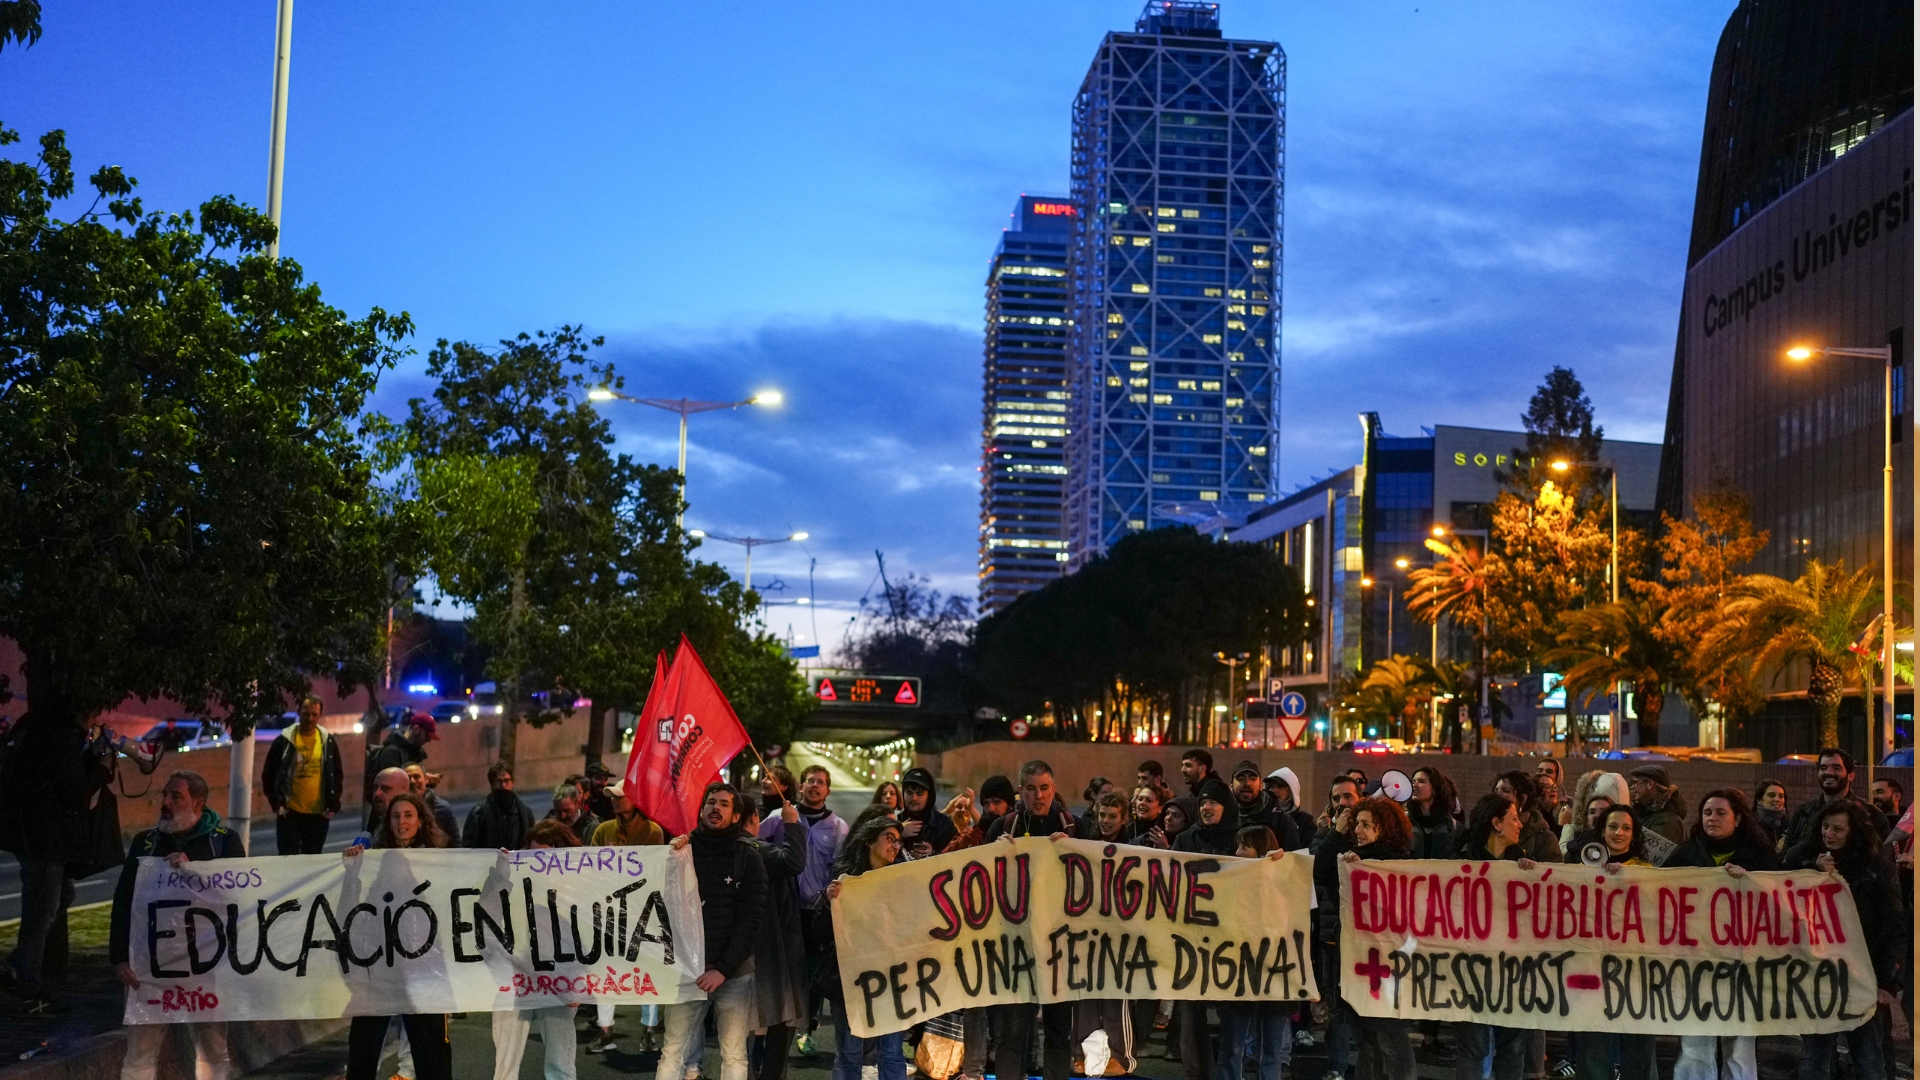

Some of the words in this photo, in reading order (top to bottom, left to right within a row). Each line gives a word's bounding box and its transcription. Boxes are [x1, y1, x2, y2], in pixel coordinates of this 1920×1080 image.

[1704, 259, 1785, 337] Campus
[1793, 167, 1914, 282] Universi
[1271, 680, 1282, 694] P
[1480, 707, 1489, 719] P
[450, 888, 514, 963] EN
[929, 853, 1030, 941] SOU
[1658, 887, 1698, 946] DE
[854, 957, 941, 1028] PER
[954, 934, 1036, 997] UNA
